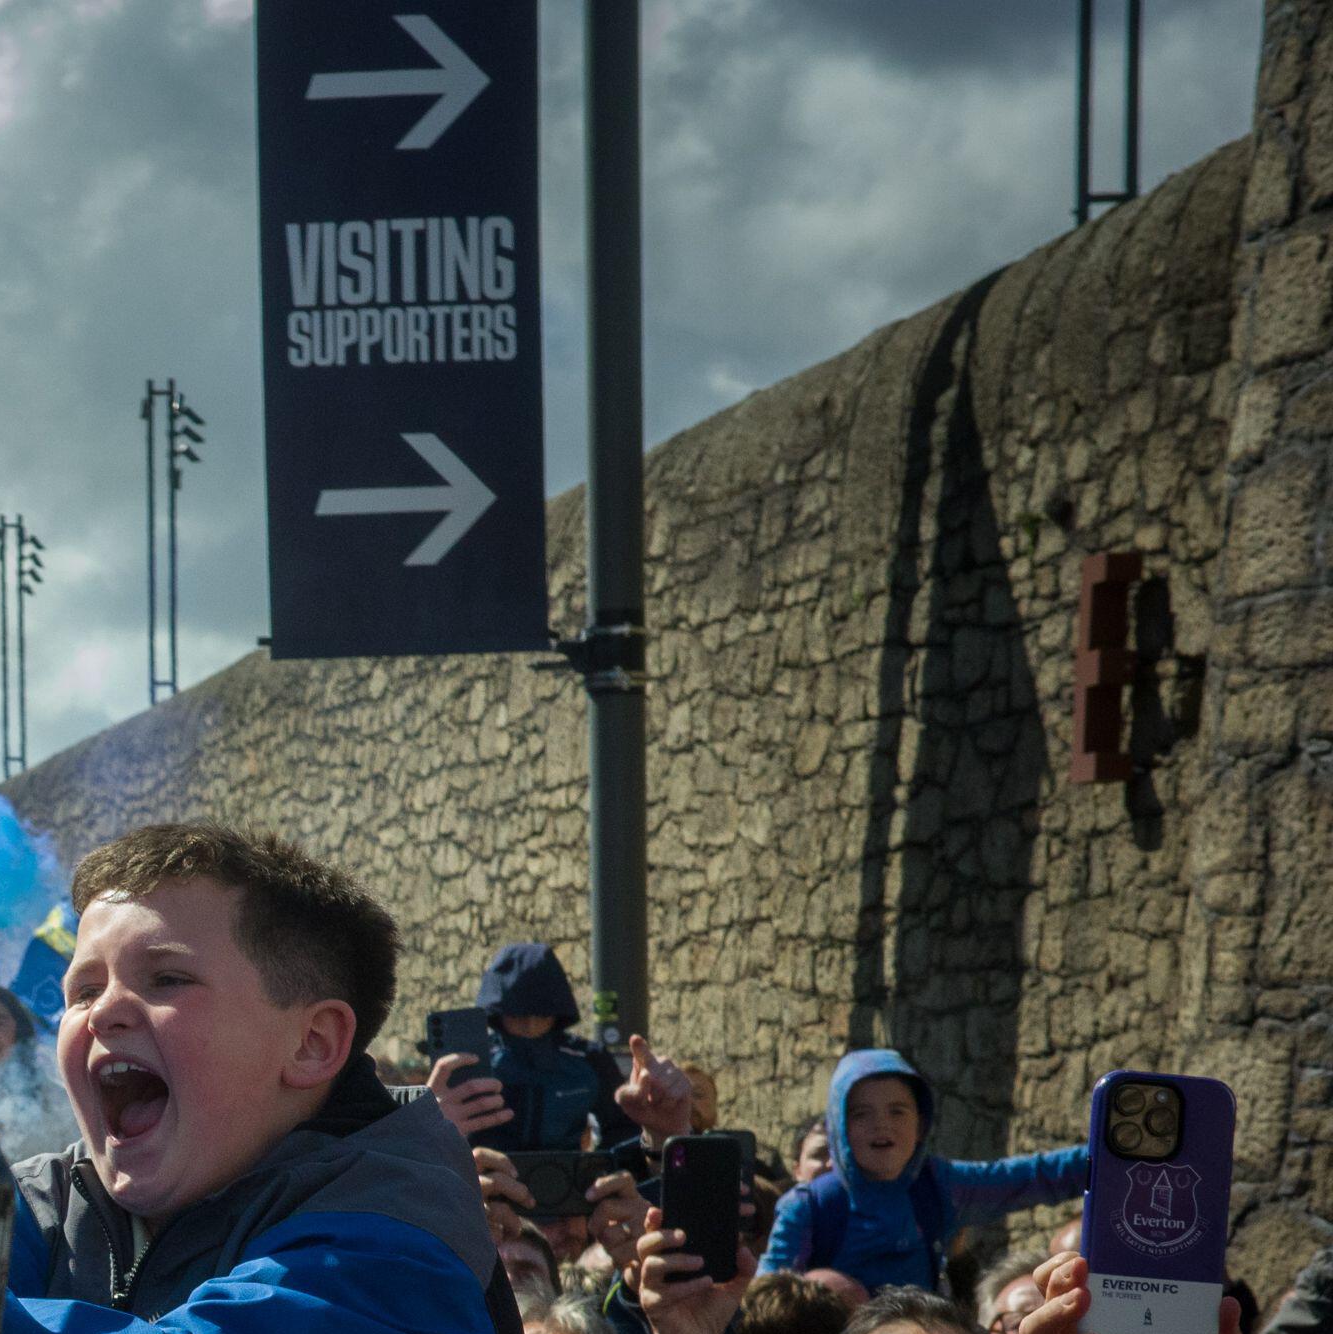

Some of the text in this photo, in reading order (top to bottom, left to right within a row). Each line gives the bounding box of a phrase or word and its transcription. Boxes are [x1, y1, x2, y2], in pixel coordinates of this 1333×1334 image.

[285, 215, 516, 308] VISITING
[287, 304, 518, 368] SUPPORTERS
[1133, 1212, 1186, 1230] Everton
[1102, 1278, 1179, 1295] EVERTON FC
